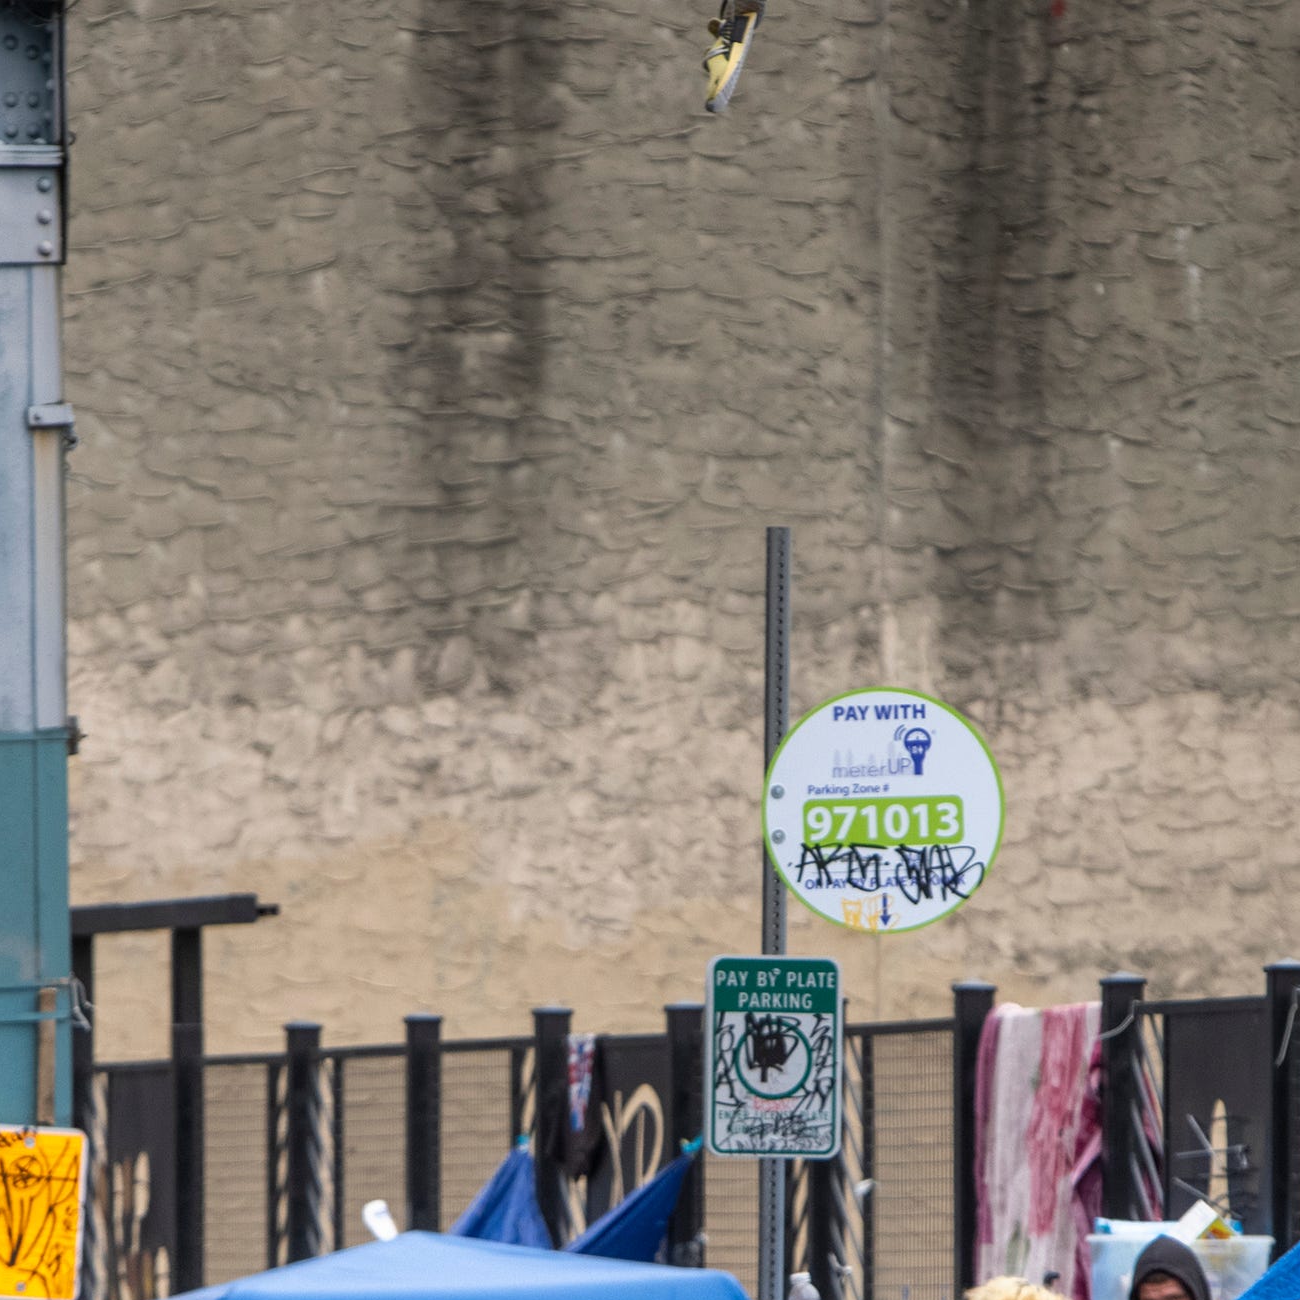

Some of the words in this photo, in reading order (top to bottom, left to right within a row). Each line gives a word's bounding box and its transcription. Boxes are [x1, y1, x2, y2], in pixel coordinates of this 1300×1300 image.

[832, 704, 868, 722] PAY
[874, 703, 927, 721] WITH
[832, 757, 912, 779] meterUP
[807, 783, 849, 797] Parking
[852, 782, 881, 795] Zone
[882, 783, 890, 793] #
[806, 801, 960, 842] 971013
[716, 970, 749, 987] PAY
[757, 970, 778, 987] BY
[786, 971, 836, 989] PLATE
[738, 991, 814, 1010] PARKING
